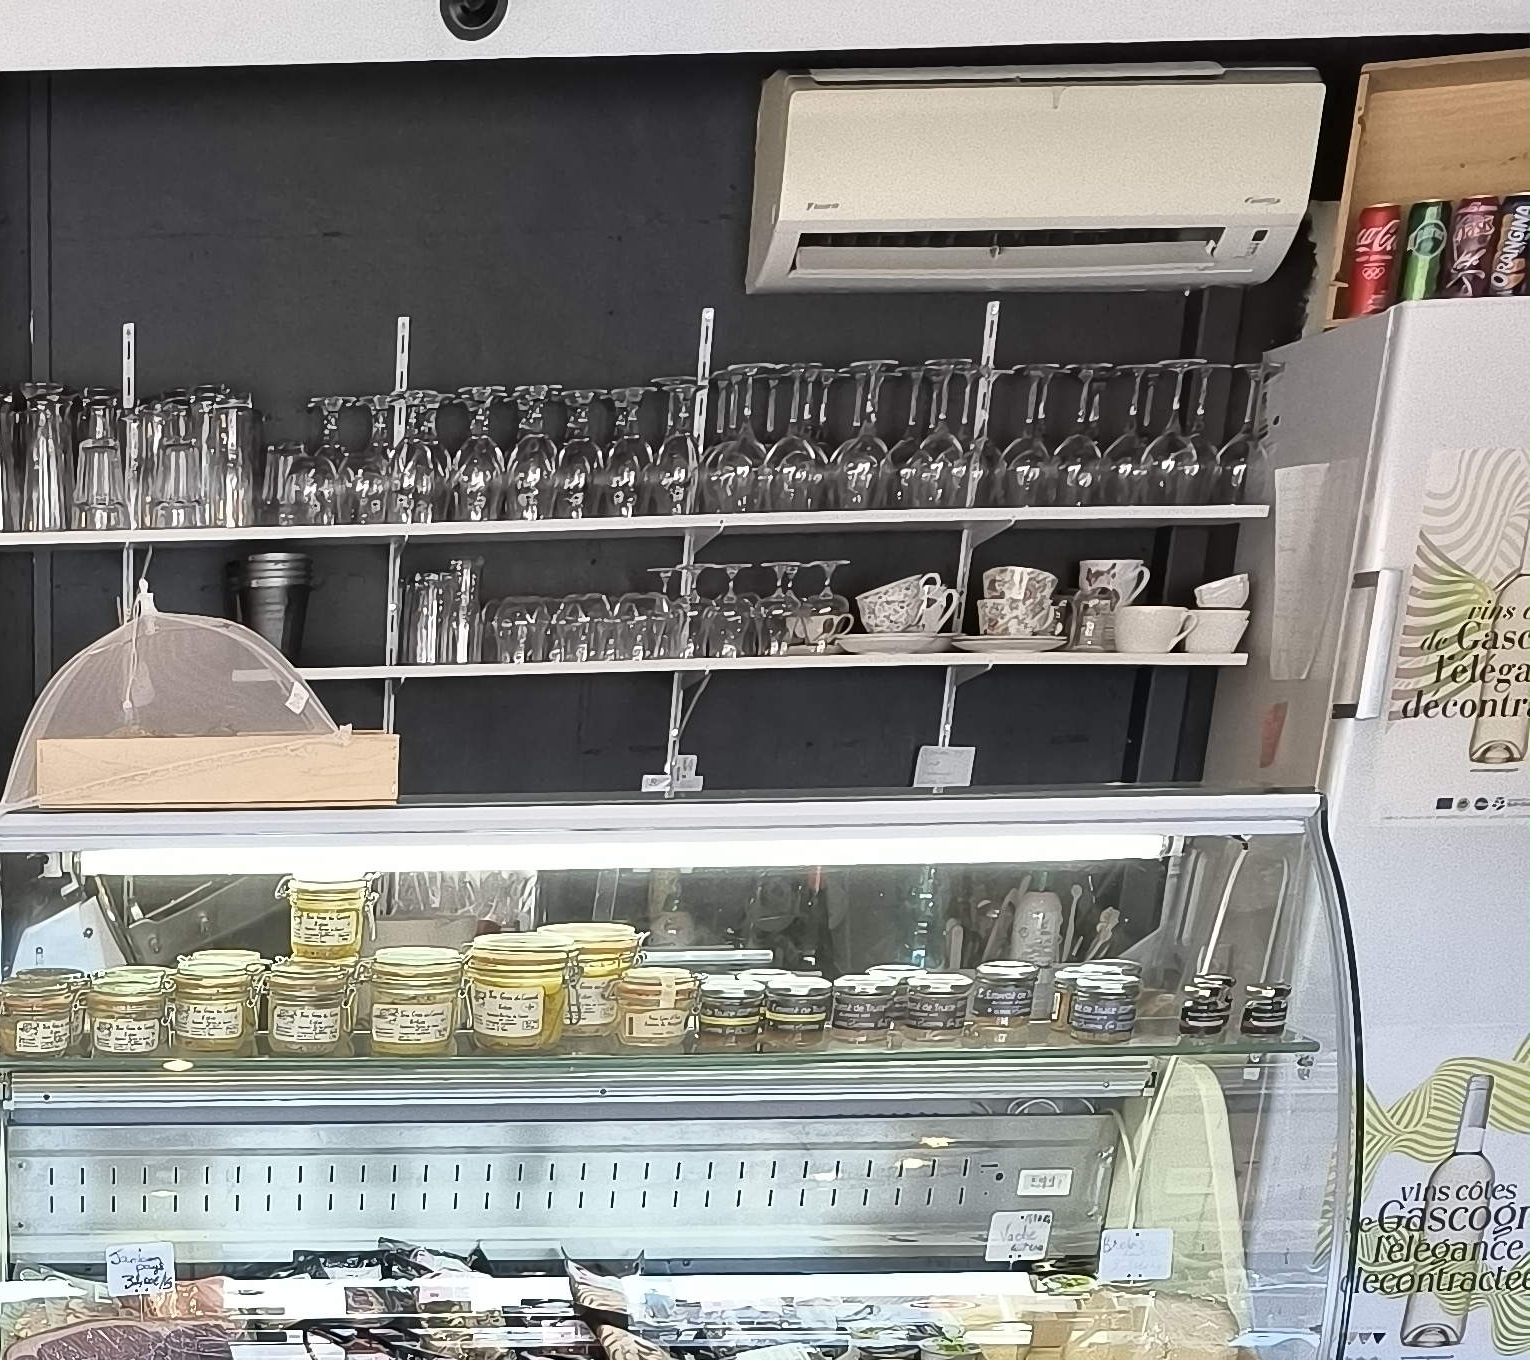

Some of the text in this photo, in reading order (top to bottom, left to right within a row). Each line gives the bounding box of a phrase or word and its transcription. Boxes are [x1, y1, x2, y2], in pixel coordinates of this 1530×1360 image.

[1490, 205, 1530, 288] ORANGINA
[1420, 629, 1447, 651] de
[1402, 689, 1530, 718] décontr
[1401, 1183, 1450, 1201] vins
